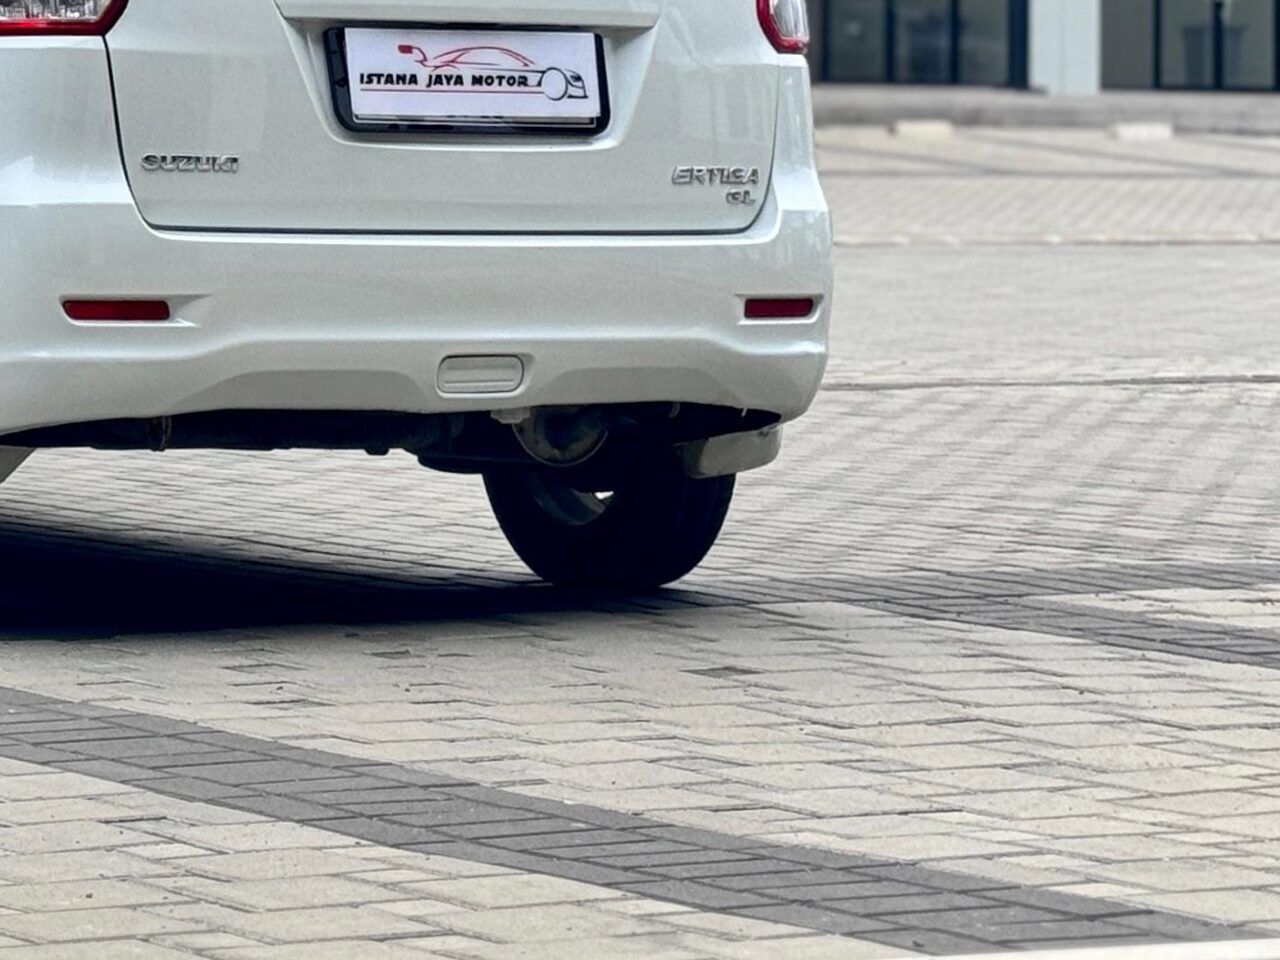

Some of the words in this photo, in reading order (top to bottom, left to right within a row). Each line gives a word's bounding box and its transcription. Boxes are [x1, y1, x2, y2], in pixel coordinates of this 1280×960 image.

[359, 72, 419, 86] ISTANA
[426, 74, 465, 88] JAYA
[471, 74, 529, 88] MOTOR
[140, 152, 241, 174] SUZUKI
[671, 165, 760, 186] ERTIGA
